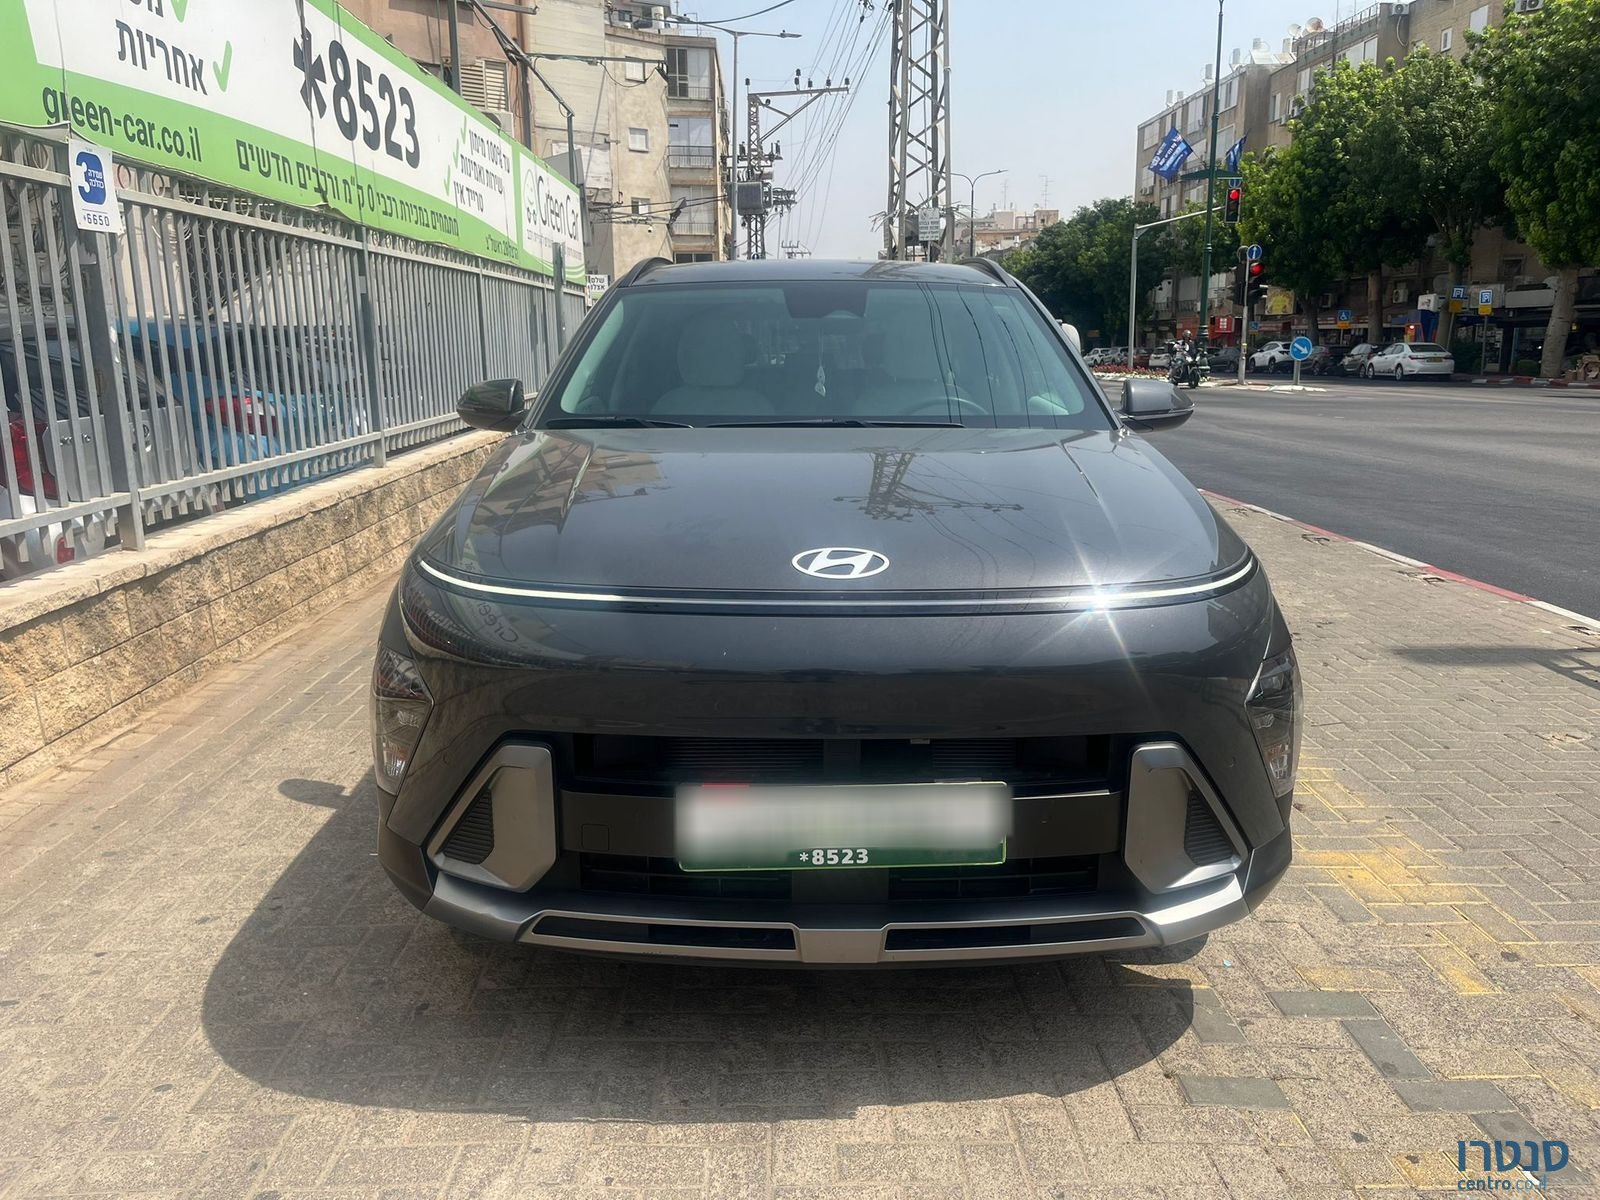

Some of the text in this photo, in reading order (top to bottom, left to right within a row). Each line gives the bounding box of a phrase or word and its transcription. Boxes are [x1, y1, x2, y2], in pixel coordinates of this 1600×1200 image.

[115, 19, 208, 96] אחריות
[42, 86, 202, 163] green-car.co.il
[235, 138, 294, 187] חדשים
[376, 191, 400, 220] רכבי
[399, 199, 430, 229] במכירת
